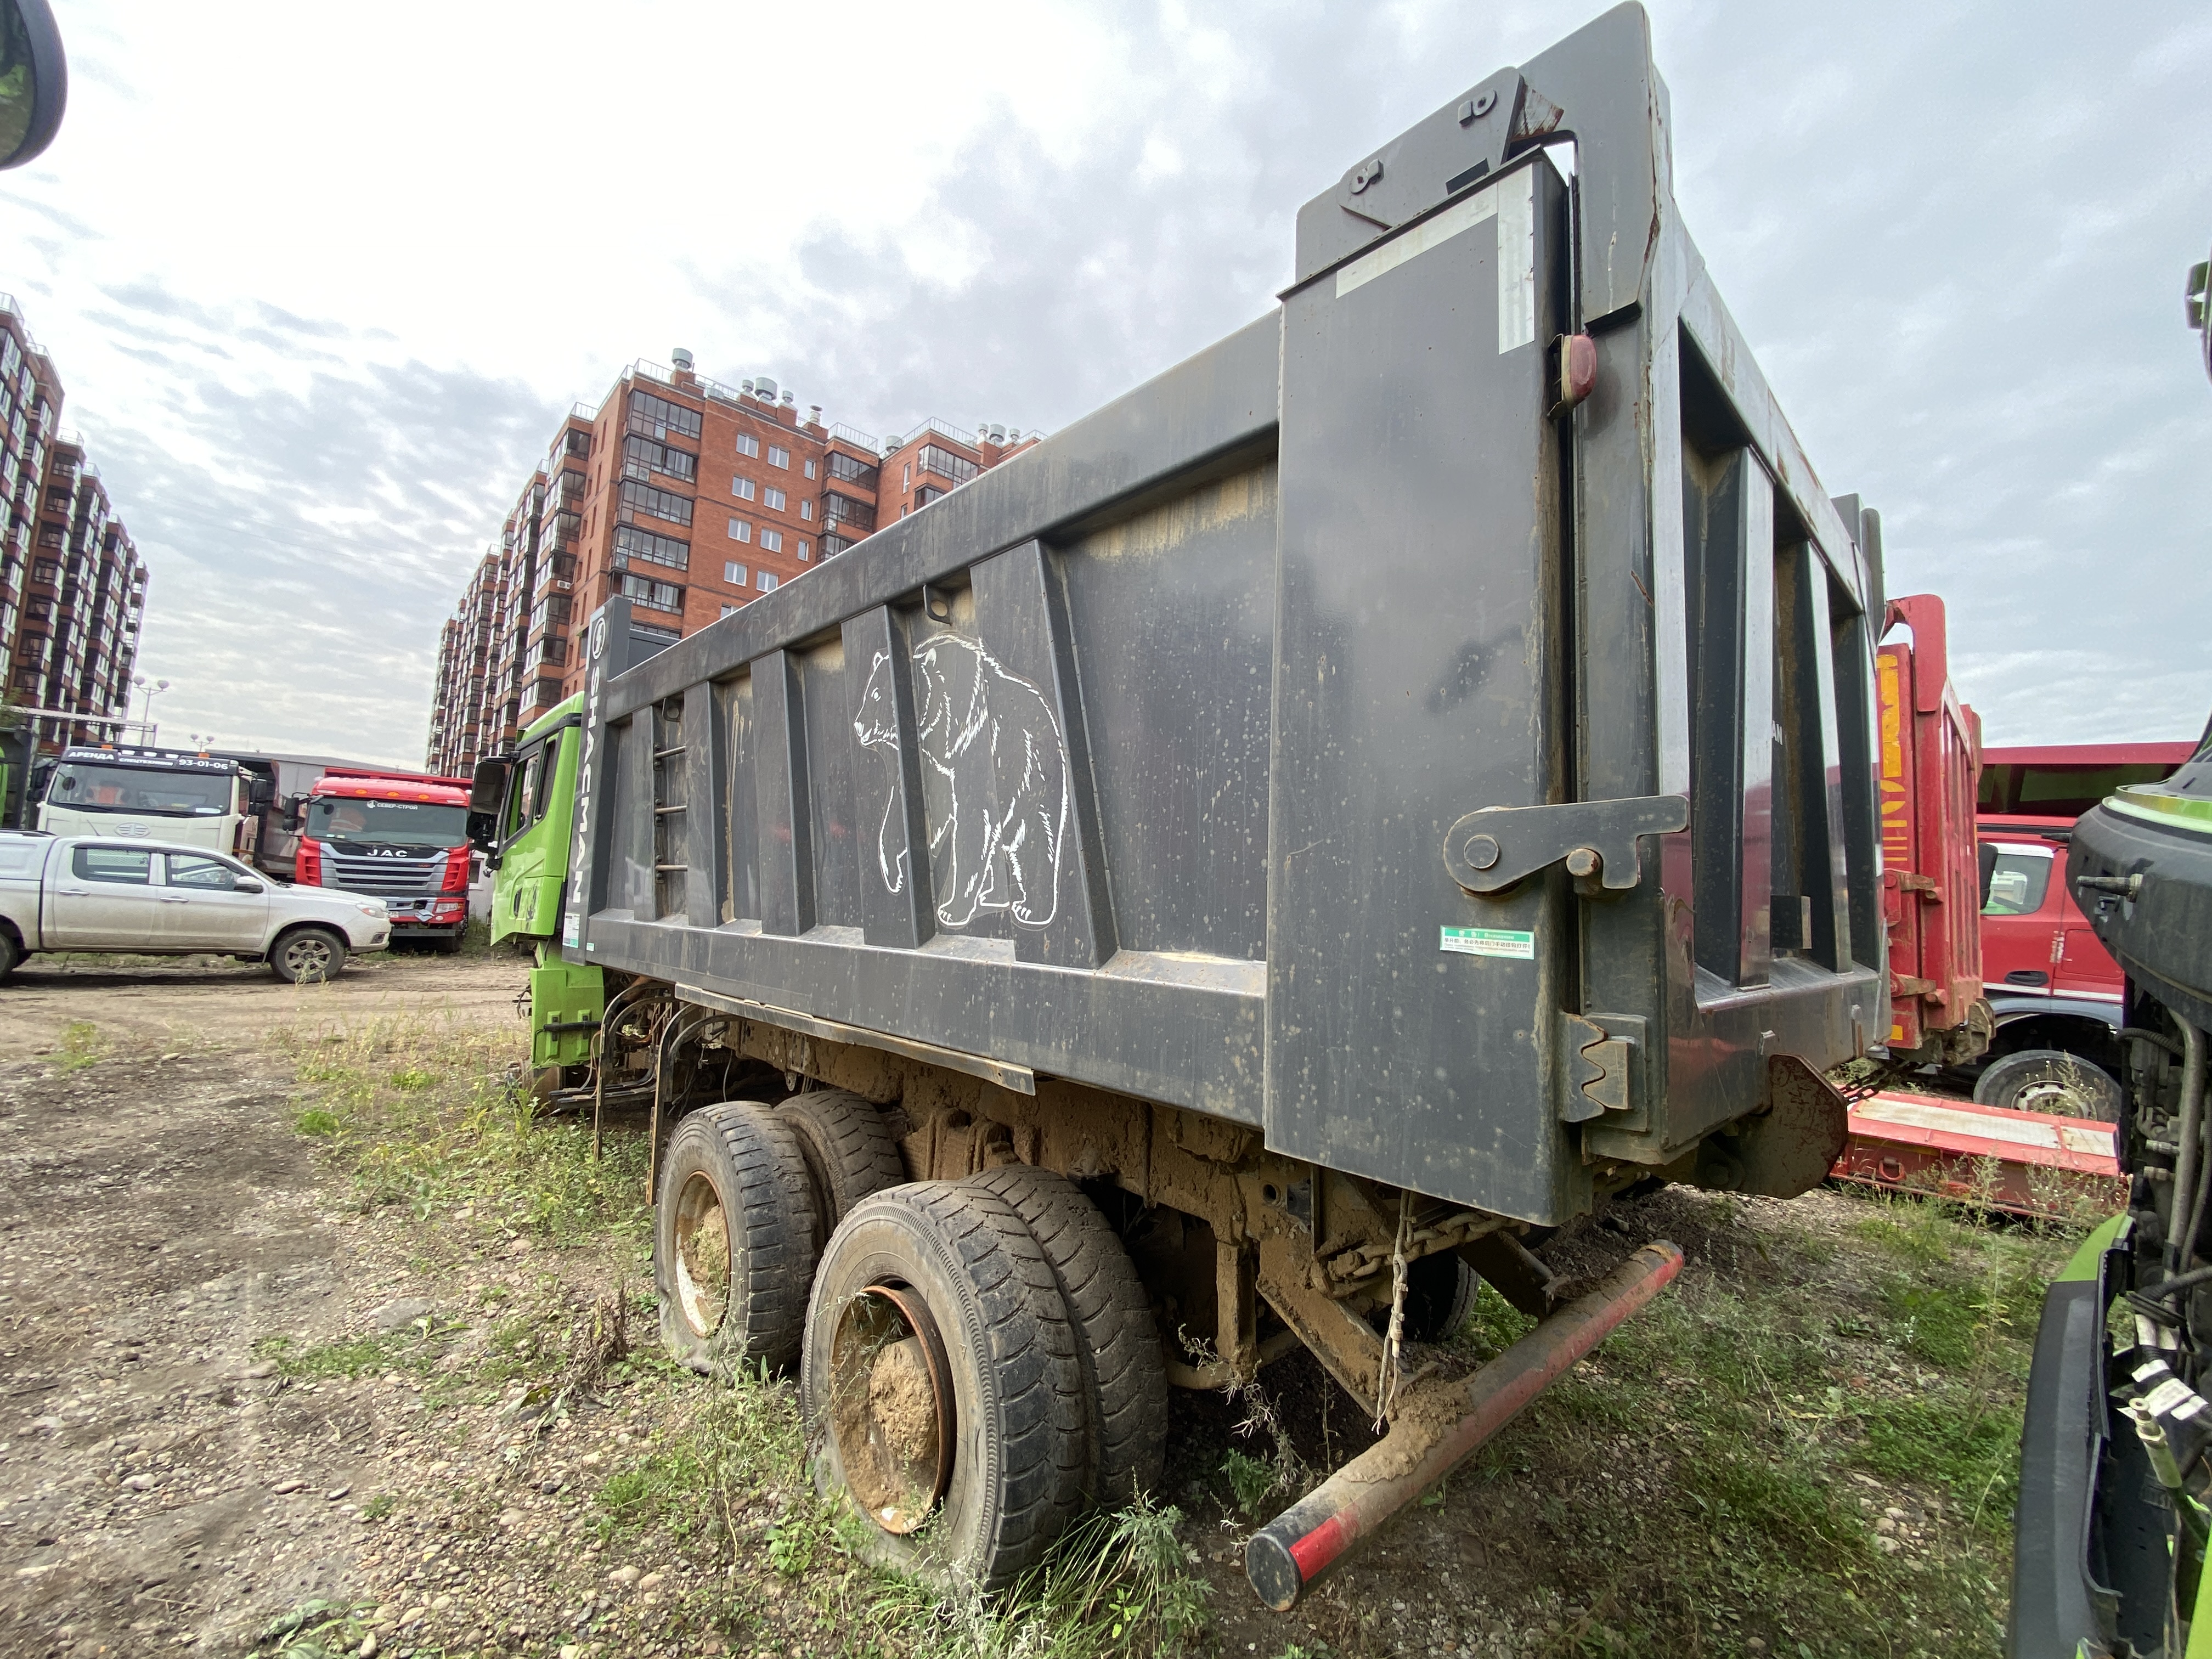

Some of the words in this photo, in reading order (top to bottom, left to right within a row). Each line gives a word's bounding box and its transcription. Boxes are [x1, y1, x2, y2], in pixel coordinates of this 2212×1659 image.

[68, 752, 114, 760] АРЕНДА
[179, 759, 228, 770] 93-01-06
[573, 666, 600, 903] SHACMAN
[367, 849, 408, 857] JAC
